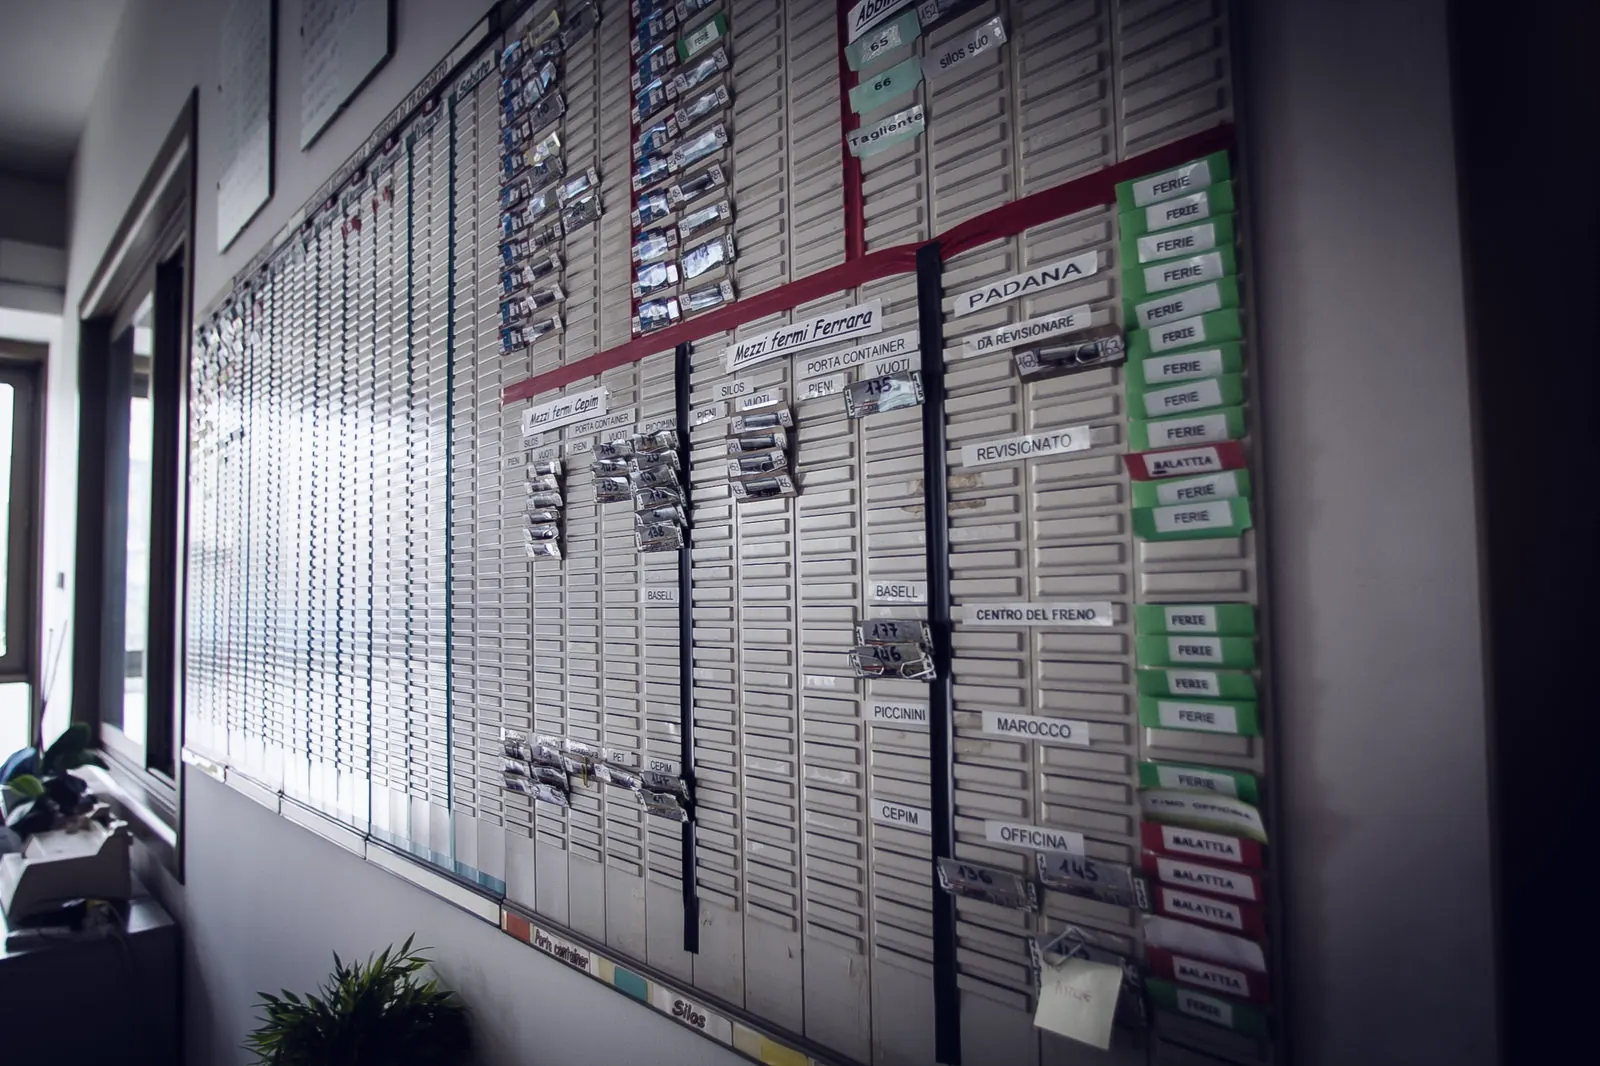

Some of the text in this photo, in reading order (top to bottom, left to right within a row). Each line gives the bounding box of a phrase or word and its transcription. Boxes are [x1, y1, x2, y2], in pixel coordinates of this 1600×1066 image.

[870, 36, 889, 51] 65
[939, 35, 989, 69] silos suo
[873, 77, 892, 91] 66
[849, 112, 924, 147] Tagliente
[1152, 175, 1191, 196] FERIE
[1165, 203, 1200, 221] FERIE
[1156, 235, 1195, 252] FERIE
[1163, 264, 1203, 282] FERIE
[968, 263, 1082, 308] PADANA
[1146, 301, 1184, 321] FERIE
[733, 308, 873, 364] Mezzi fermi Ferrara
[977, 314, 1075, 350] DA REVISIONARE
[1162, 326, 1196, 344] FERIE
[807, 338, 906, 374] PORTA CONTAINER
[876, 358, 910, 376] VUOTI
[1163, 360, 1201, 375] FERIE
[721, 381, 745, 398] SILOS
[808, 380, 833, 394] PIENI
[1163, 391, 1200, 407] FERIE
[530, 408, 550, 425] Mezzi
[574, 395, 599, 413] Cepim
[575, 413, 629, 434] PORTA CONTAINER
[1167, 425, 1206, 439] FERIE
[523, 437, 538, 448] SILOS
[608, 430, 628, 442] VUOTI
[976, 434, 1073, 461] REVISIONATO
[1153, 455, 1213, 471] MALATTIA
[1176, 484, 1216, 500] FERIE
[1173, 510, 1210, 525] FERIE
[648, 590, 674, 601] BASELL
[876, 585, 918, 598] BASELL
[976, 608, 1096, 621] CENTRO DEL FRENO
[1171, 614, 1206, 625] FERIE
[1177, 645, 1213, 656] FERIE
[1175, 678, 1209, 690] FERIE
[874, 706, 926, 721] PICCININI
[1178, 710, 1216, 724] FERIE
[997, 717, 1072, 739] MAROCCO
[613, 752, 625, 763] PET
[650, 760, 672, 773] CEPIM
[1178, 774, 1217, 790] FERIE
[882, 806, 919, 825] CEPIM
[1000, 826, 1068, 851] OFFICINA
[1172, 836, 1234, 855] MALATTIA
[1059, 857, 1099, 882] 145
[1172, 869, 1235, 890] MALATTIA
[1172, 898, 1234, 921] MALATTIA
[1179, 964, 1242, 990] MALATTIA
[672, 999, 706, 1028] Silos
[1185, 998, 1221, 1017] FERIE
